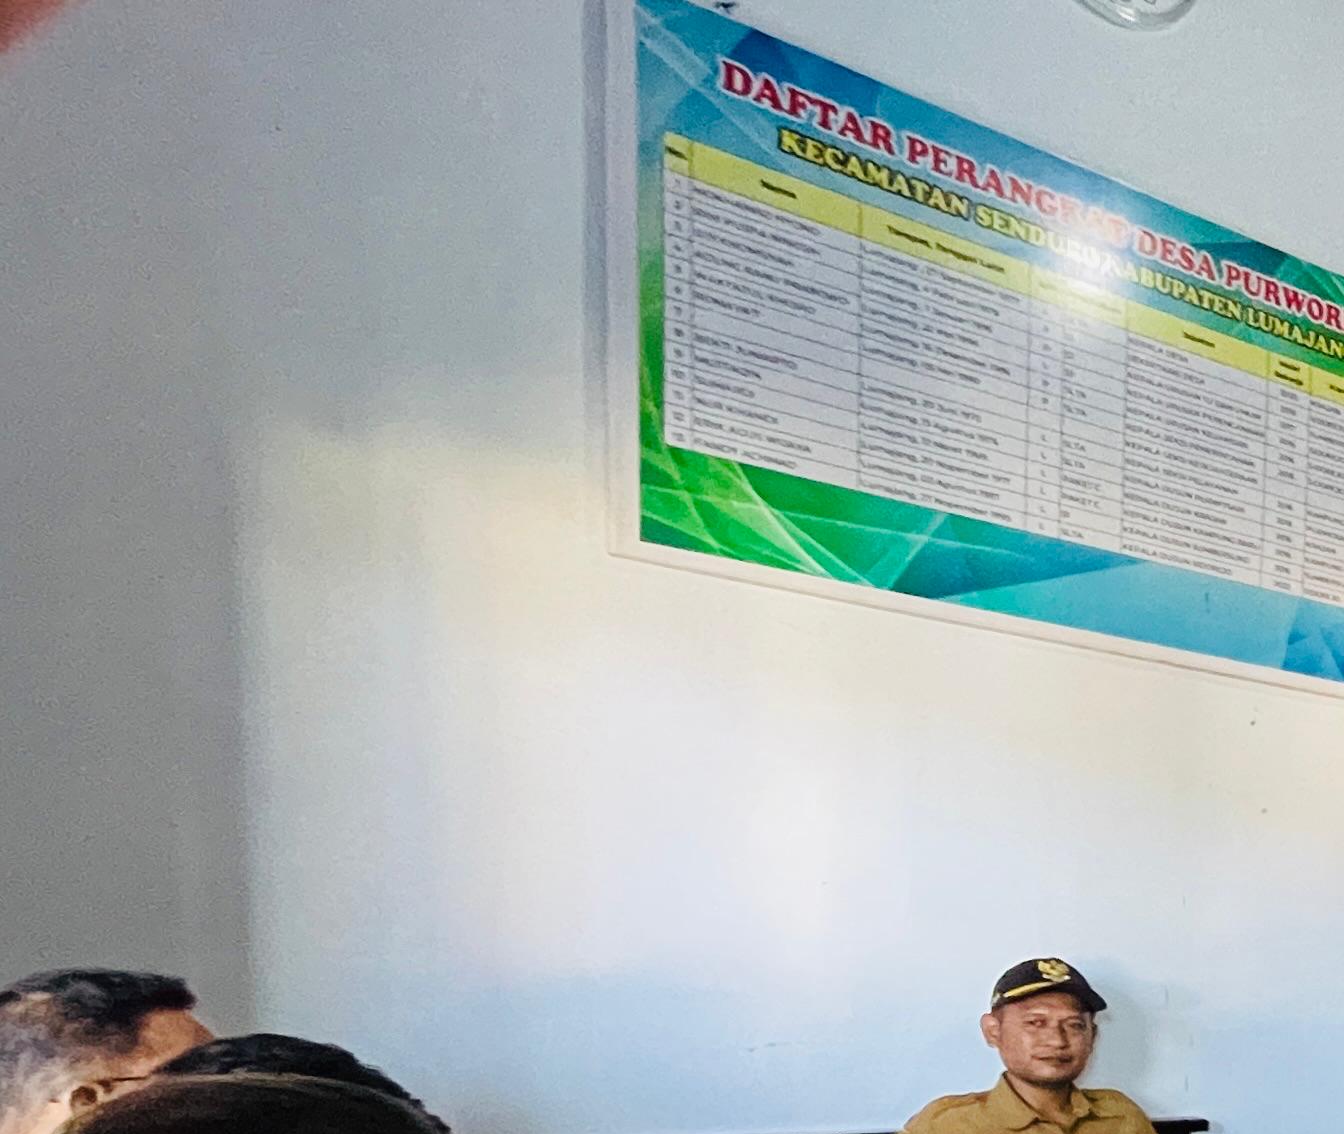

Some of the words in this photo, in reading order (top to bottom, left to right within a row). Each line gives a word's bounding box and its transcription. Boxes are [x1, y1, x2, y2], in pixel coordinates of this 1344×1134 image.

[720, 58, 895, 156] DAFTAR
[1136, 227, 1218, 282] DESA
[779, 125, 971, 222] KECAMATAN
